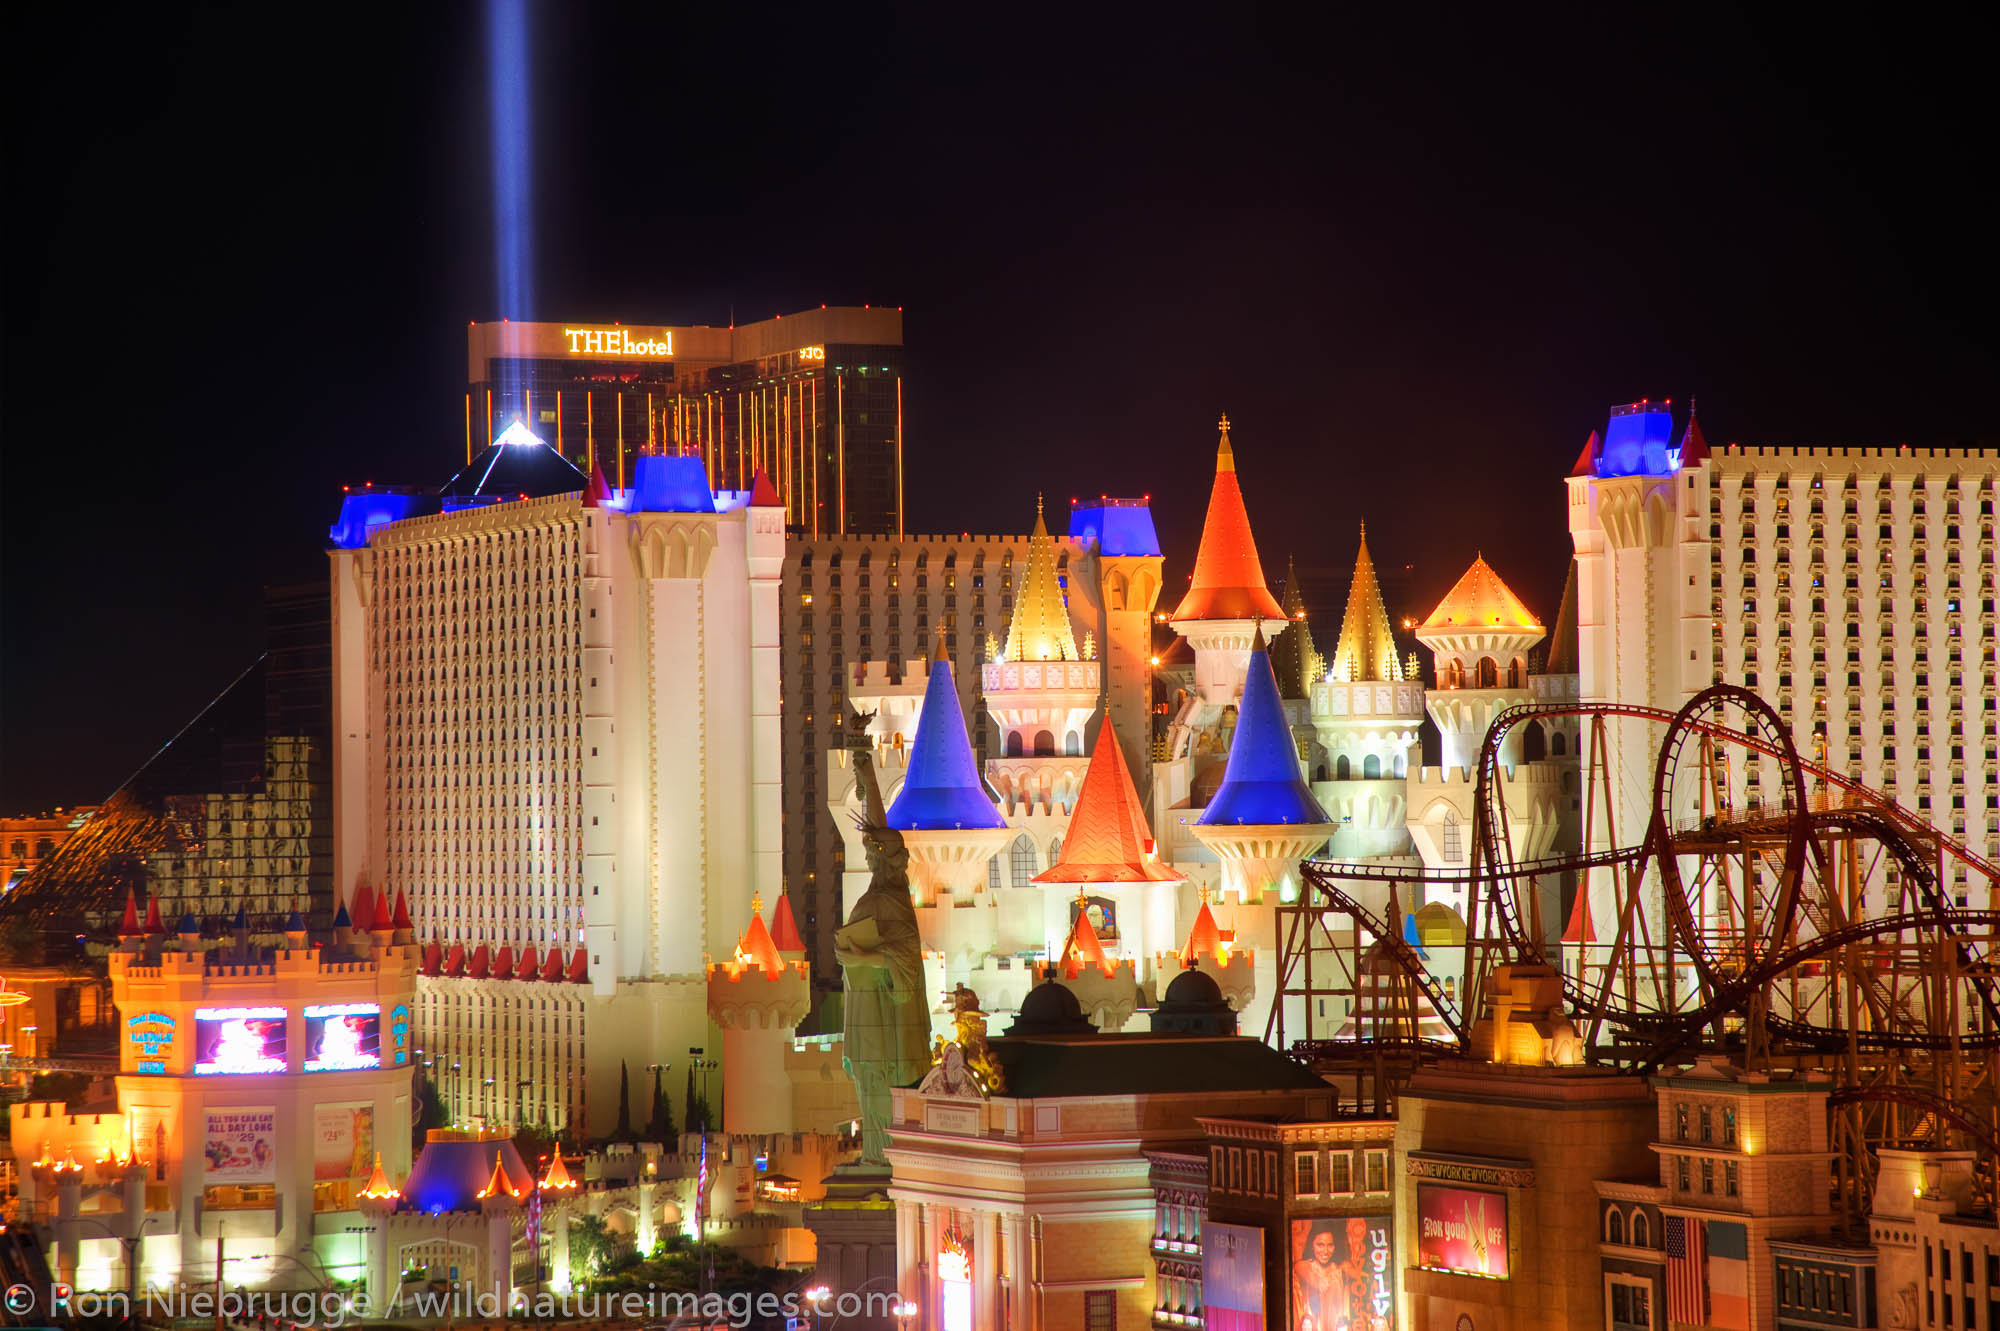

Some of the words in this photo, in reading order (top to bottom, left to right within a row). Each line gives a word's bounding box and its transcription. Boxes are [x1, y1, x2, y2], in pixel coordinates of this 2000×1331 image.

[241, 1114, 256, 1122] CAN
[208, 1124, 225, 1133] ALL
[228, 1124, 246, 1132] DAY
[249, 1123, 272, 1132] LONG
[1369, 1229, 1391, 1326] ugly
